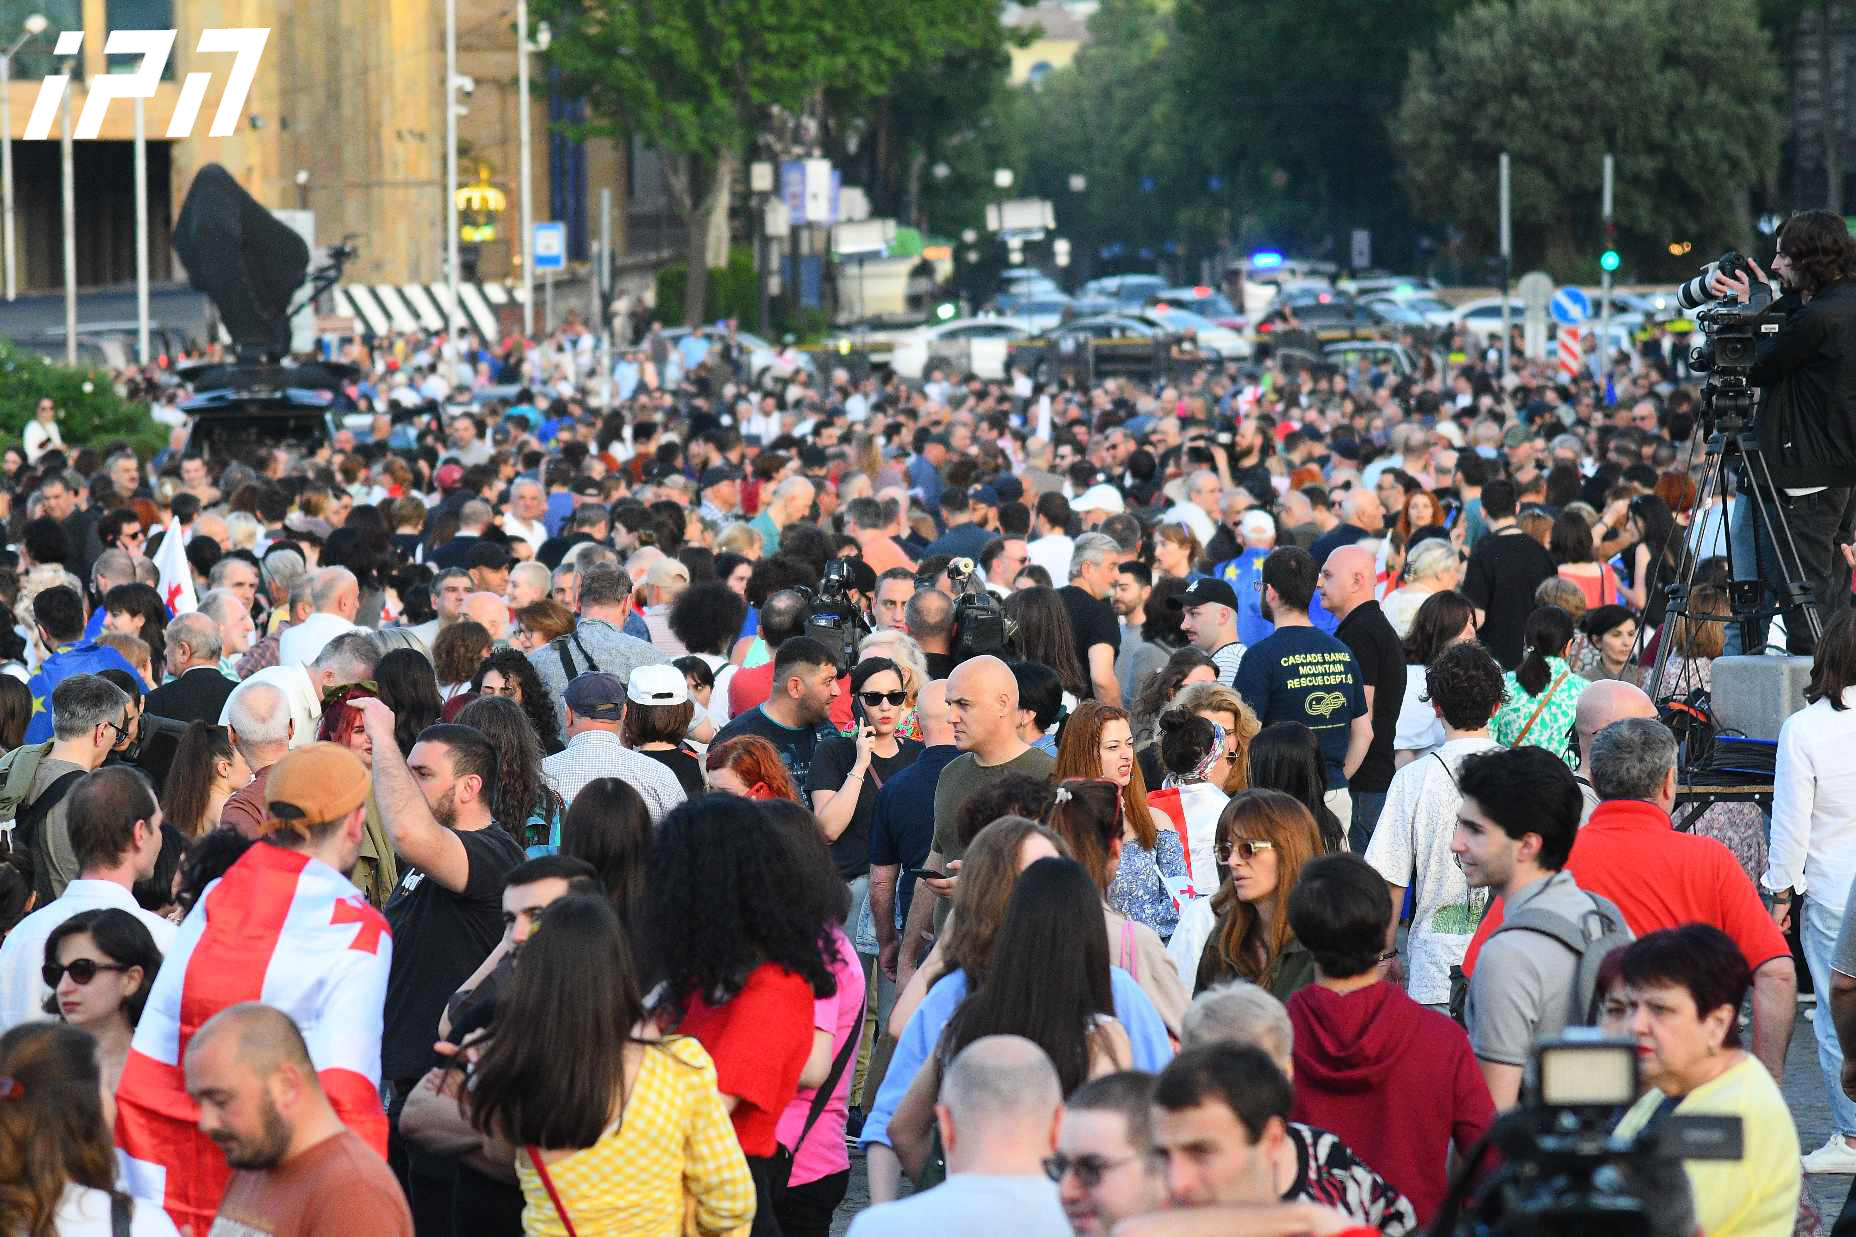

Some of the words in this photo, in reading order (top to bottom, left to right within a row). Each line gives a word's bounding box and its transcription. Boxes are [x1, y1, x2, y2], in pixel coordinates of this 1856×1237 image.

[1280, 653, 1323, 667] CASCADE
[1324, 652, 1351, 662] RANGE
[1299, 663, 1344, 675] MOUNTAIN
[1287, 676, 1324, 689] RESCUE
